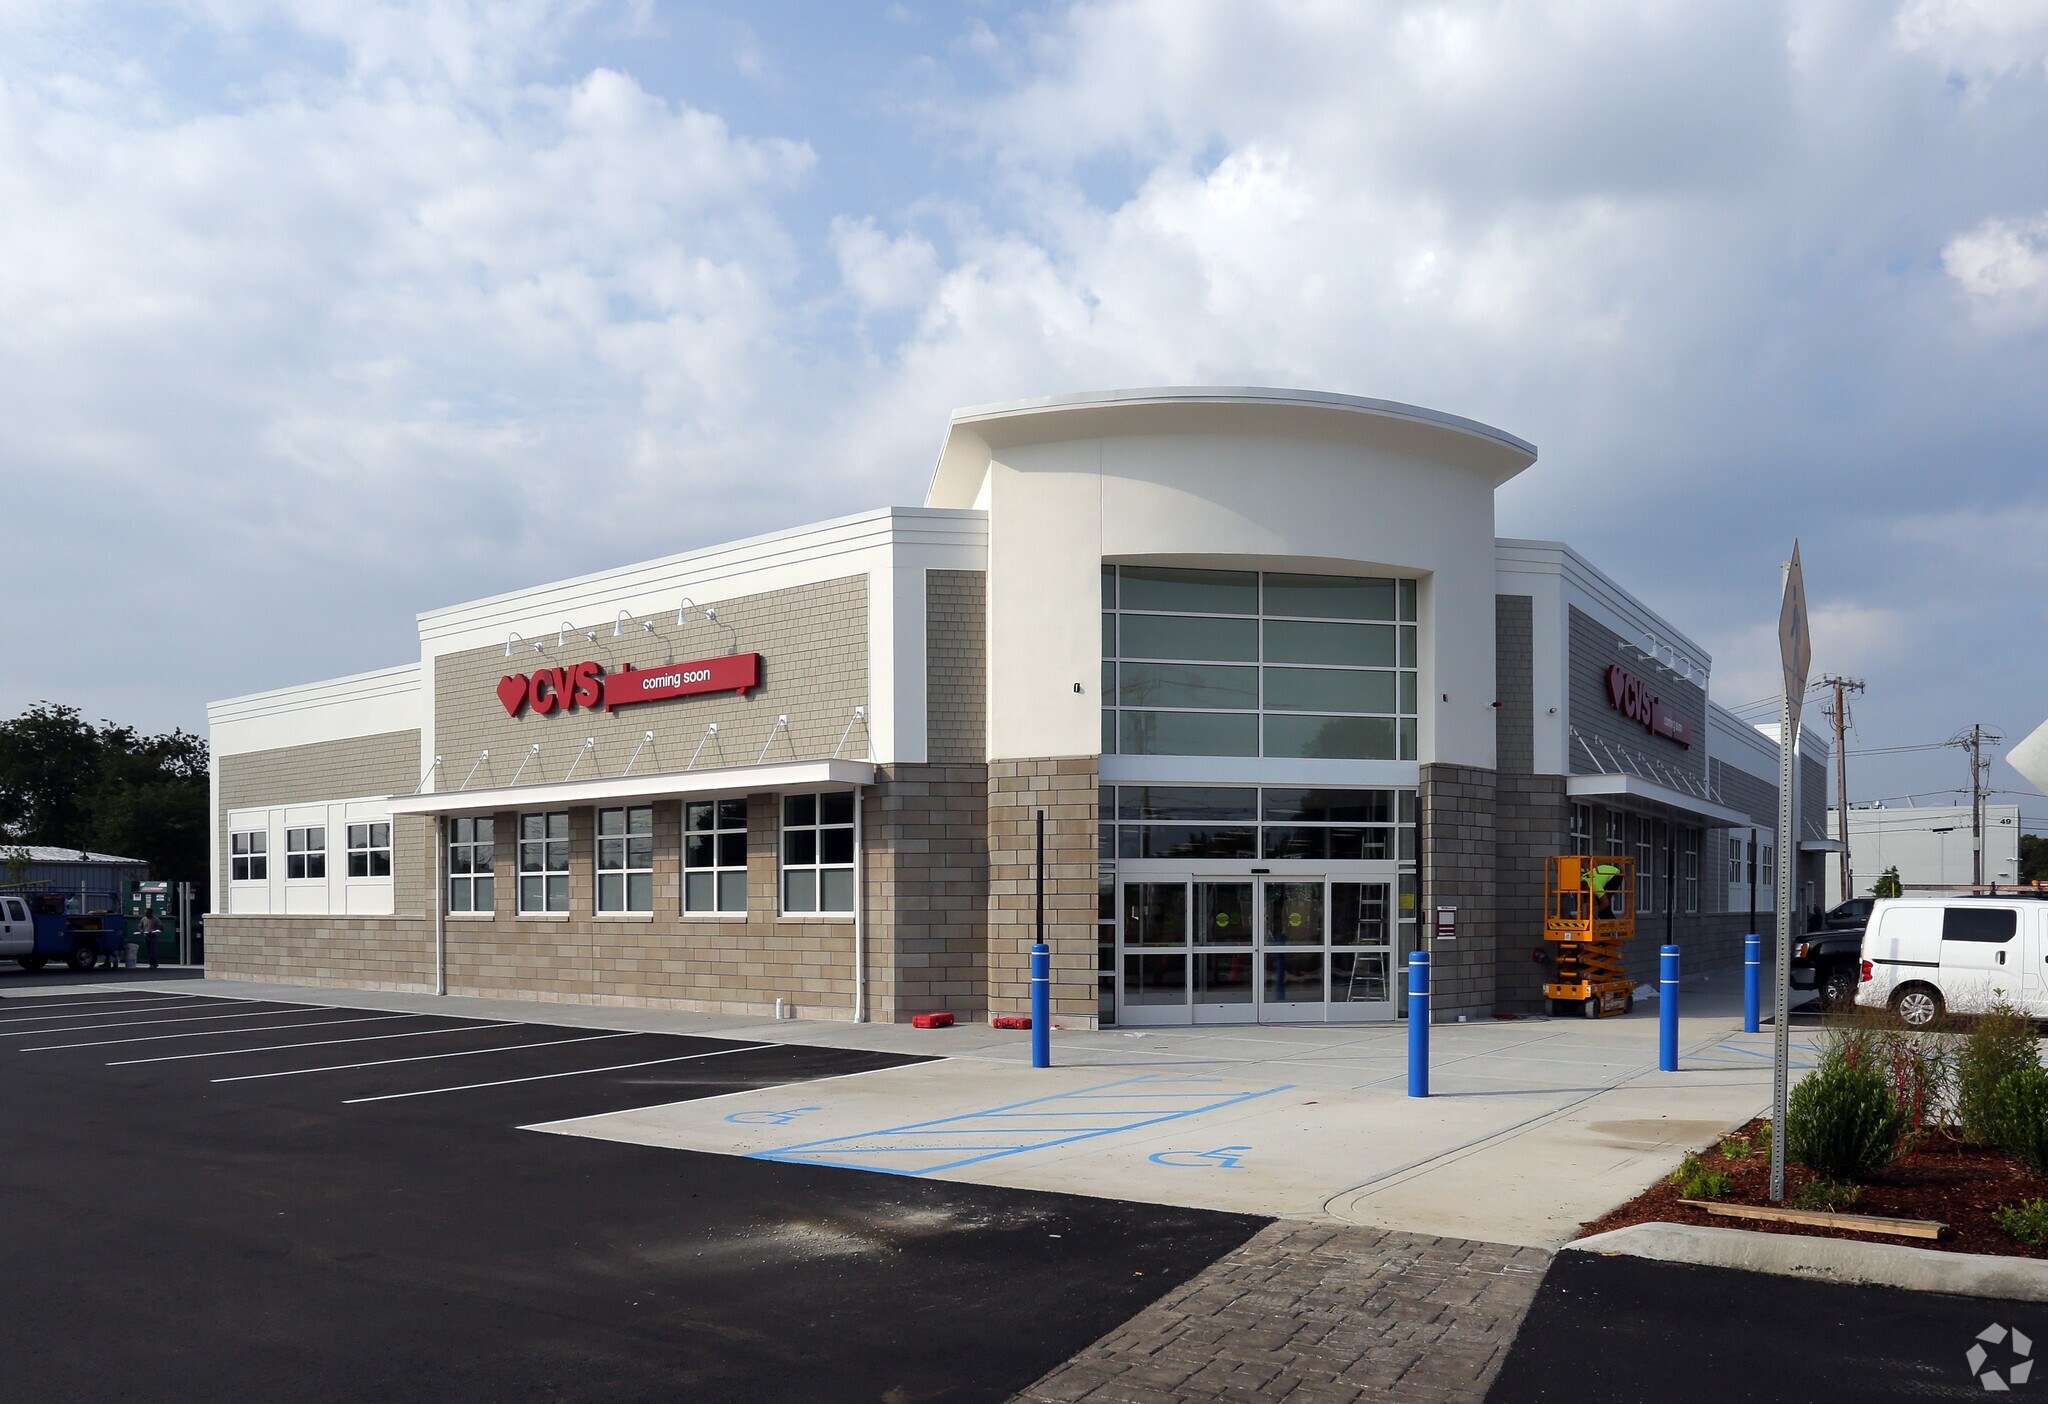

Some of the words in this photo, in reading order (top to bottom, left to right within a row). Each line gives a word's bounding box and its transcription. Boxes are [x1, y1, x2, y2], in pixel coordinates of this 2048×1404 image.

[528, 660, 602, 714] CVS
[642, 672, 681, 690] coming
[683, 669, 711, 684] soon
[1622, 673, 1652, 726] CVS
